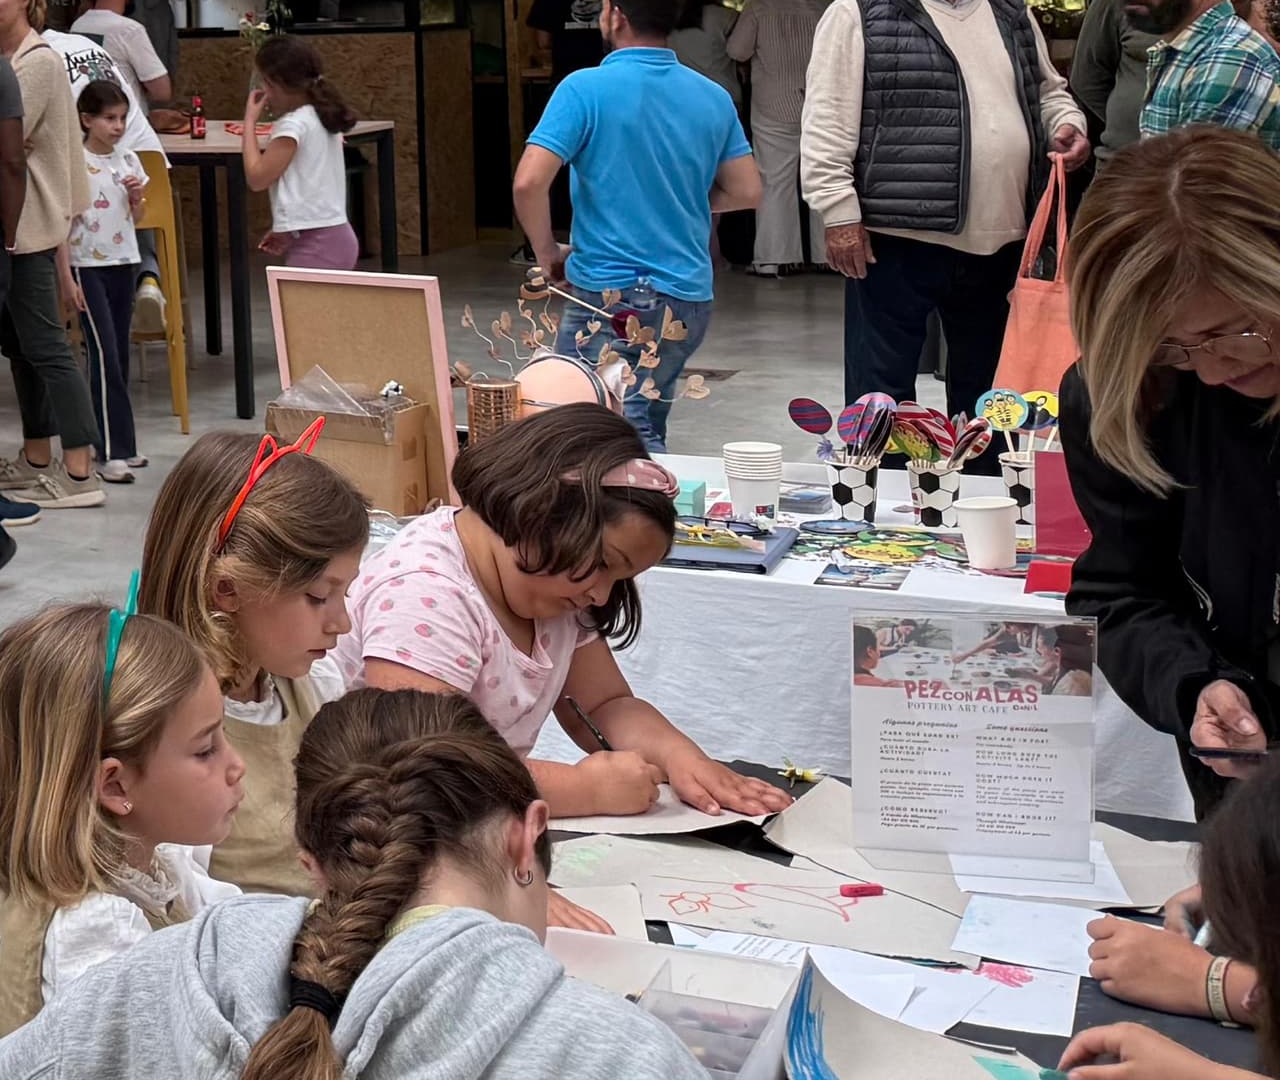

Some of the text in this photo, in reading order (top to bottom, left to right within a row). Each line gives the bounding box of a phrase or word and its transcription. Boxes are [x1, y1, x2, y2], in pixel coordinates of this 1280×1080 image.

[975, 684, 1039, 704] ALAS
[907, 701, 953, 712] POTTERY
[958, 704, 978, 713] ART
